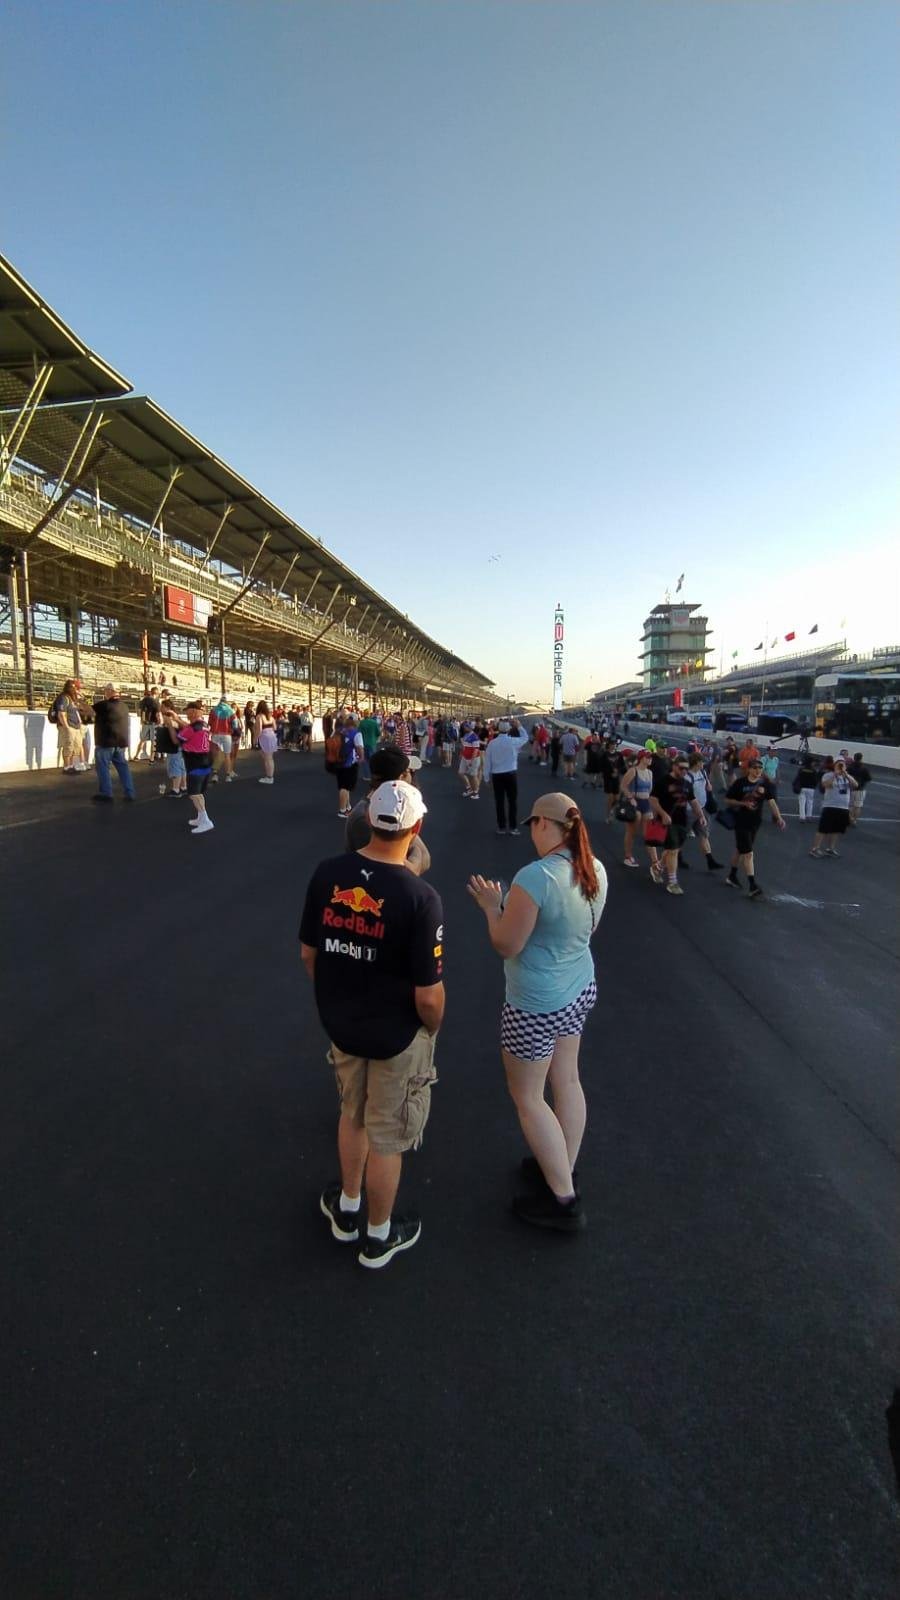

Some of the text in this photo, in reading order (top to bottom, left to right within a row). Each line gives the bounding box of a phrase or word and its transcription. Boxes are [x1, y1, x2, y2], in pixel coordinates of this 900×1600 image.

[323, 907, 384, 939] Red Bull
[325, 938, 361, 960] Mobil
